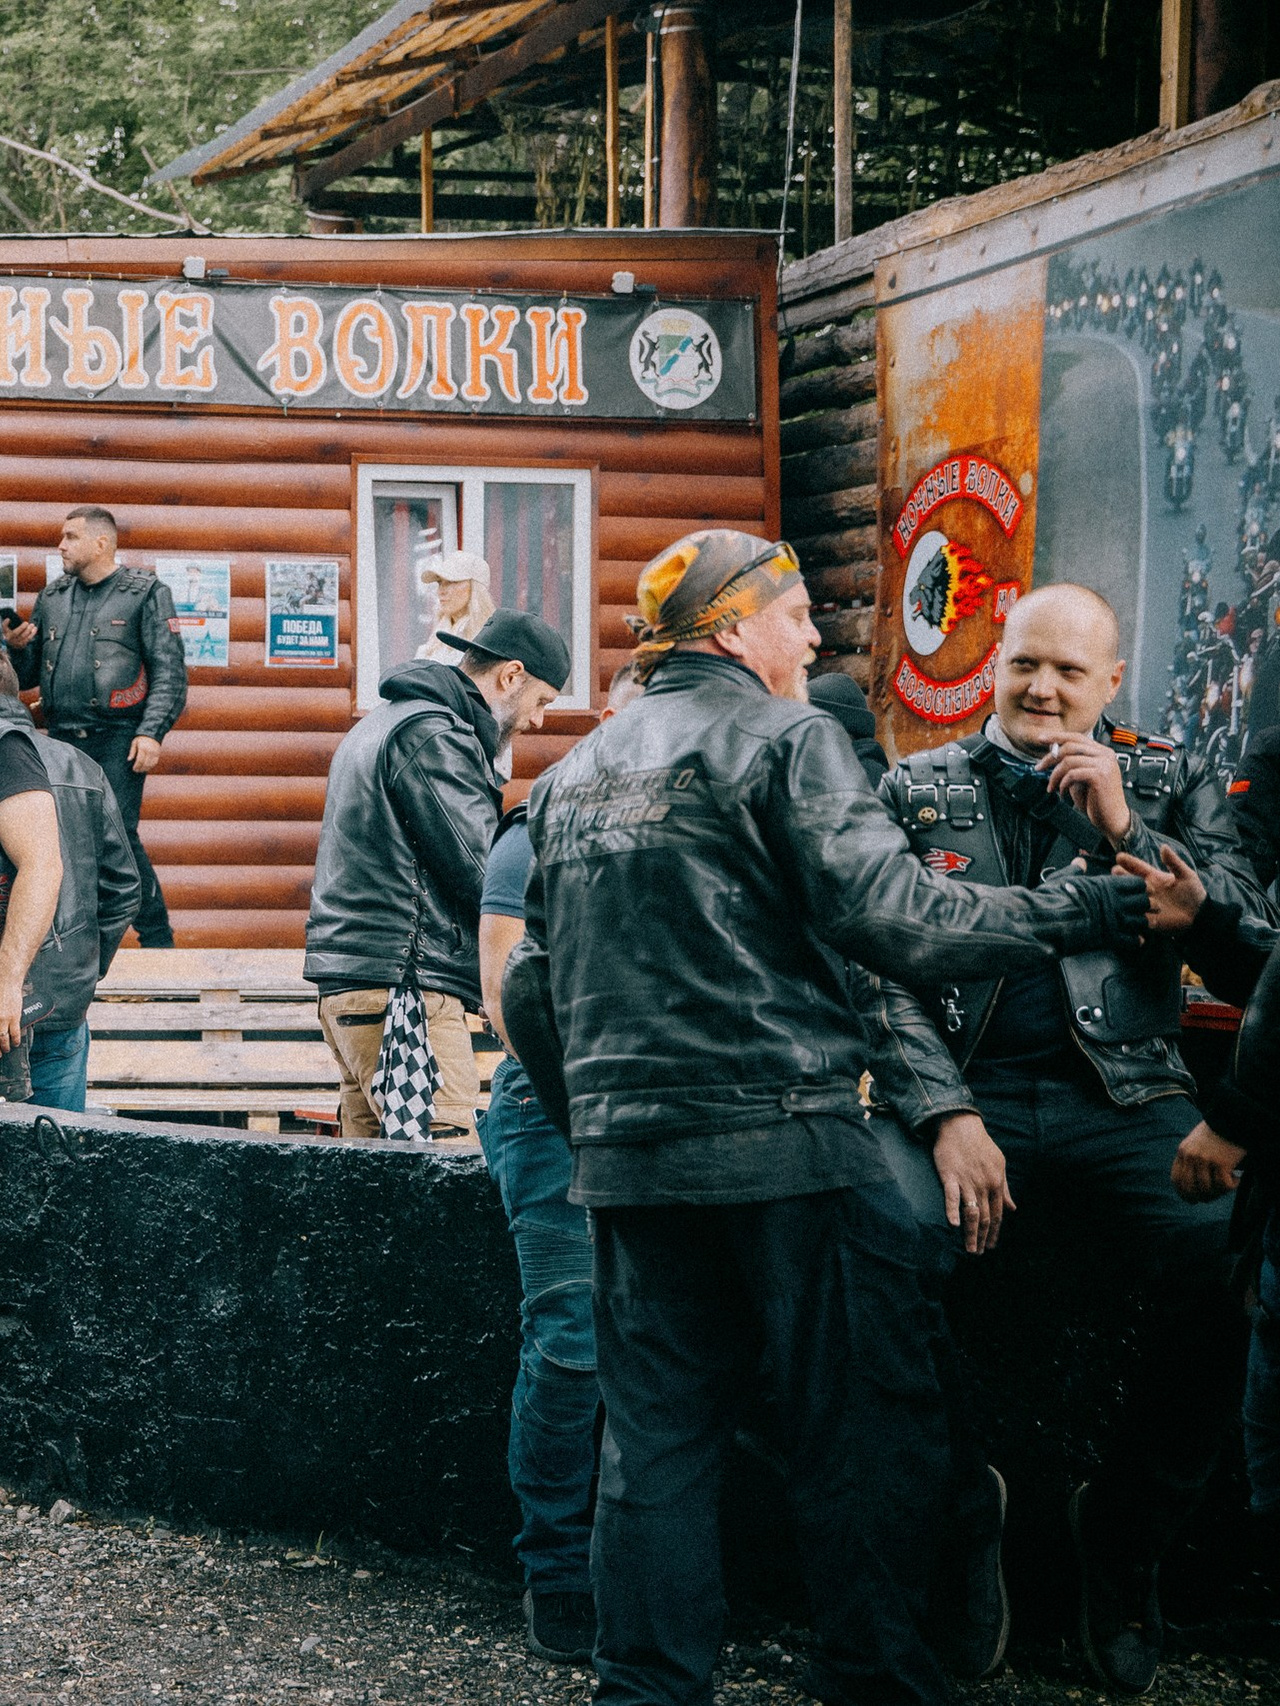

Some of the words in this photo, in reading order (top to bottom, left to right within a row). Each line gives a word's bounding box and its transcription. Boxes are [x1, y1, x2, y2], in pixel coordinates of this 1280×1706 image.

[256, 295, 589, 405] ВОЛКИ
[897, 461, 961, 548] НОЧНЫЕ
[964, 460, 1019, 528] ВОЛКИ
[282, 619, 323, 635] ПОБЕДА
